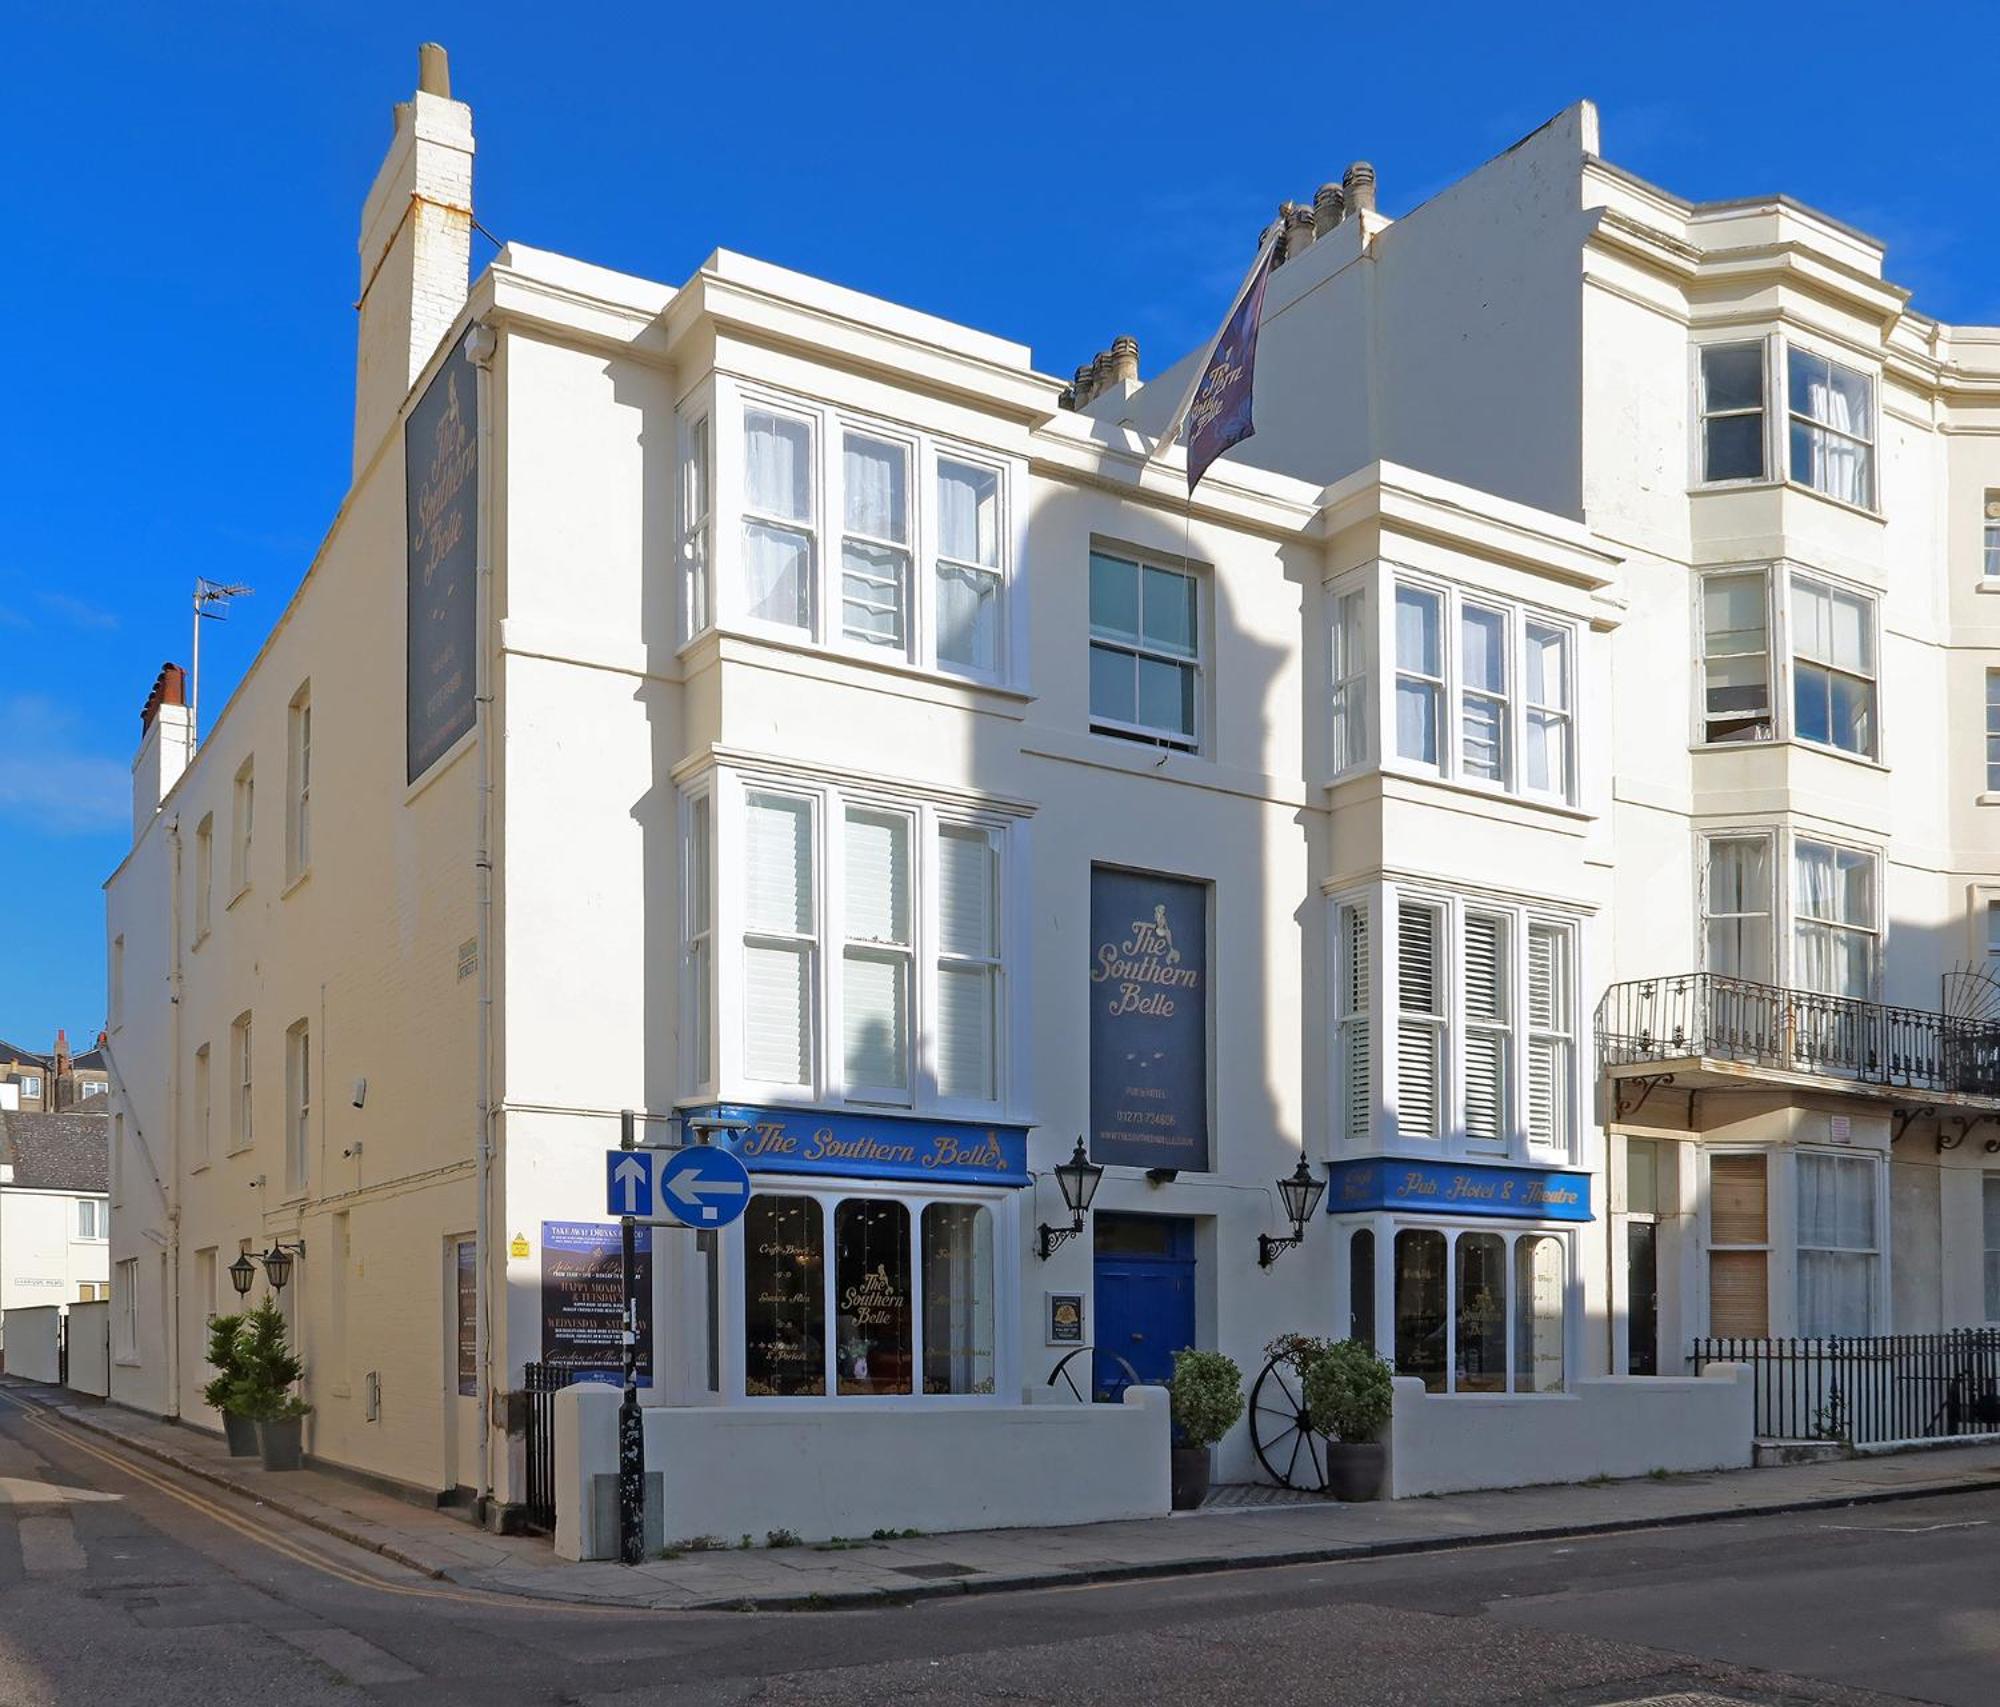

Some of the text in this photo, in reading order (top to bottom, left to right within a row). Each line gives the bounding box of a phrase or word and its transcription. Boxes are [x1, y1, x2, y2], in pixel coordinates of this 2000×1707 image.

[1122, 921, 1167, 957] The
[1091, 943, 1198, 989] Southern
[1109, 982, 1176, 1018] Belle
[744, 1121, 998, 1170] The Southern Belle
[1446, 1175, 1495, 1201] Hotel
[1500, 1181, 1514, 1200] &
[1521, 1181, 1579, 1205] Theatre
[840, 1288, 905, 1311] Southern
[859, 1273, 886, 1294] The
[852, 1306, 892, 1328] Belle
